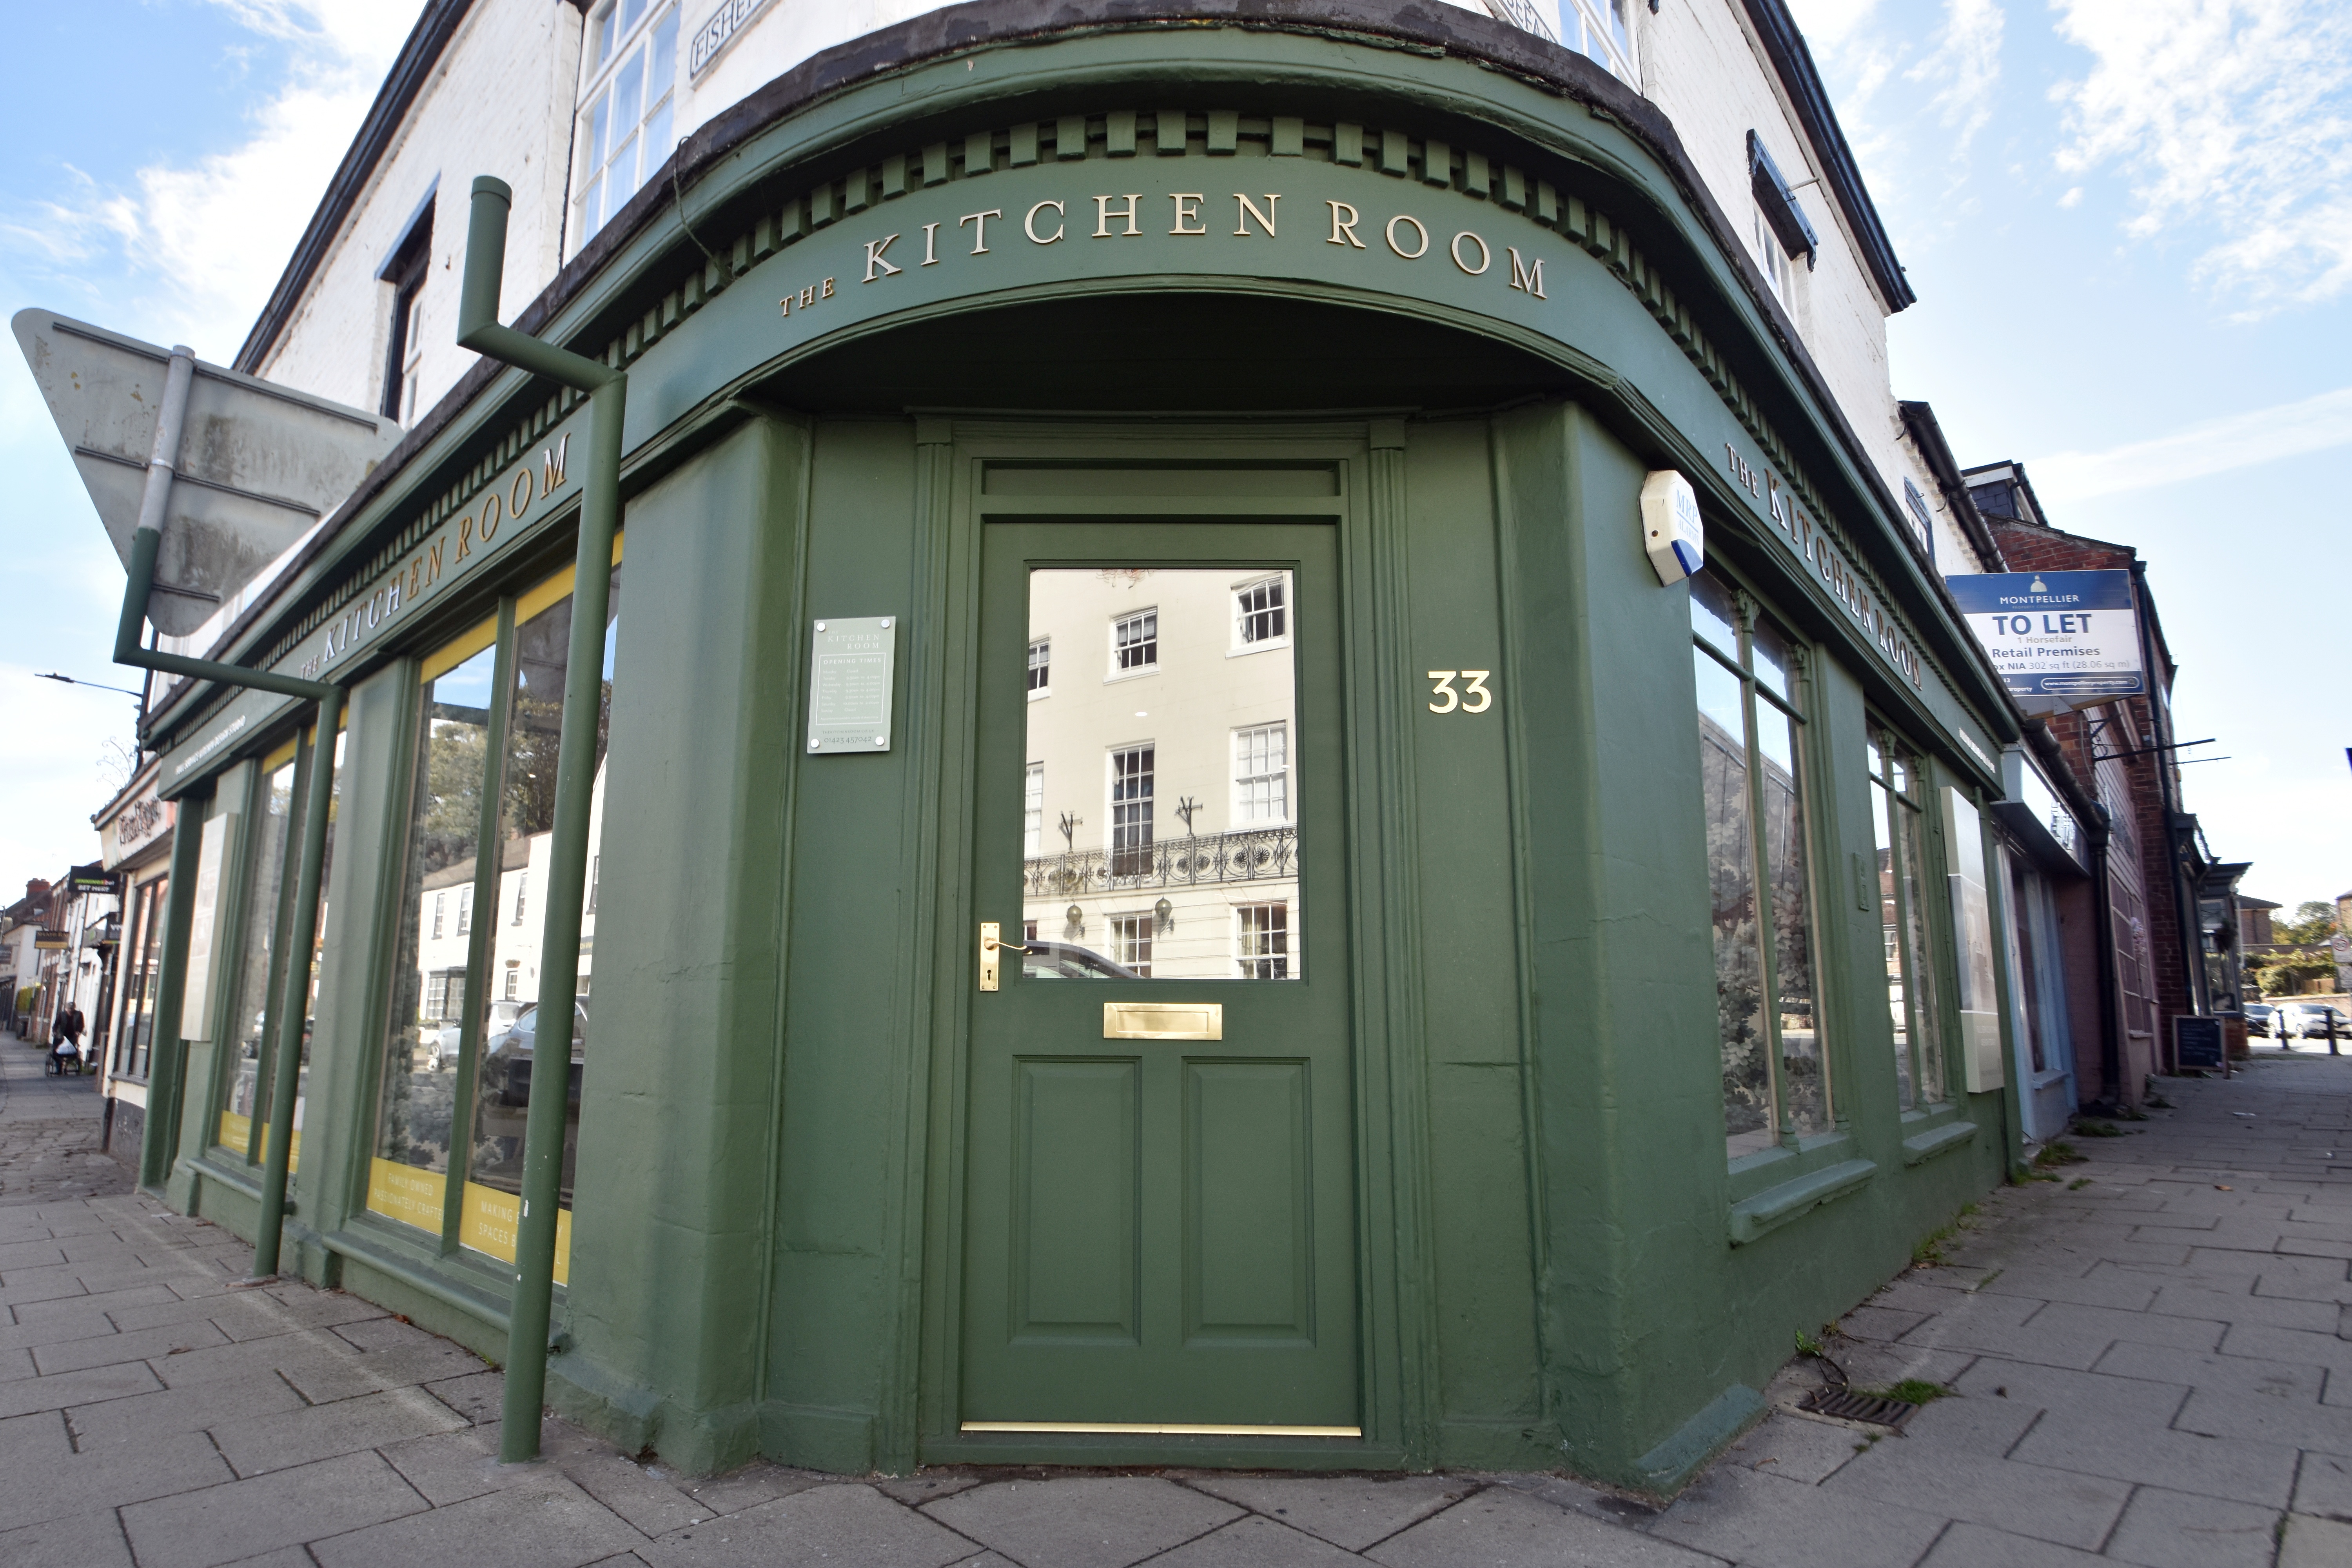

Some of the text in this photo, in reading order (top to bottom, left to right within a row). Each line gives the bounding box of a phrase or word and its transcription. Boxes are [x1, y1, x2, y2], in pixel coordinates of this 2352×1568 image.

[779, 193, 1548, 317] THE KITCHEN ROOM
[1676, 488, 1698, 524] MRP
[1678, 519, 1699, 546] ALARMS
[299, 432, 572, 681] THE KITCHEN ROOM
[1725, 442, 1922, 691] THE KITCHEN ROOM
[2000, 595, 2080, 604] MONTPELLIER
[1992, 613, 2092, 636] TO LET
[2026, 635, 2073, 644] Horsefair
[1992, 646, 2101, 658] Retail Premises
[2029, 662, 2047, 670] 302
[2049, 662, 2060, 671] sq
[2073, 661, 2102, 670] (28.06
[2105, 661, 2115, 670] sq
[2117, 660, 2130, 669] m)
[1428, 670, 1492, 715] 33
[388, 1172, 434, 1196] FAMILY OWNED
[374, 1188, 443, 1221] PASSIONATELY CRAFTE
[481, 1200, 513, 1222] MAKING
[478, 1222, 508, 1245] SPACES
